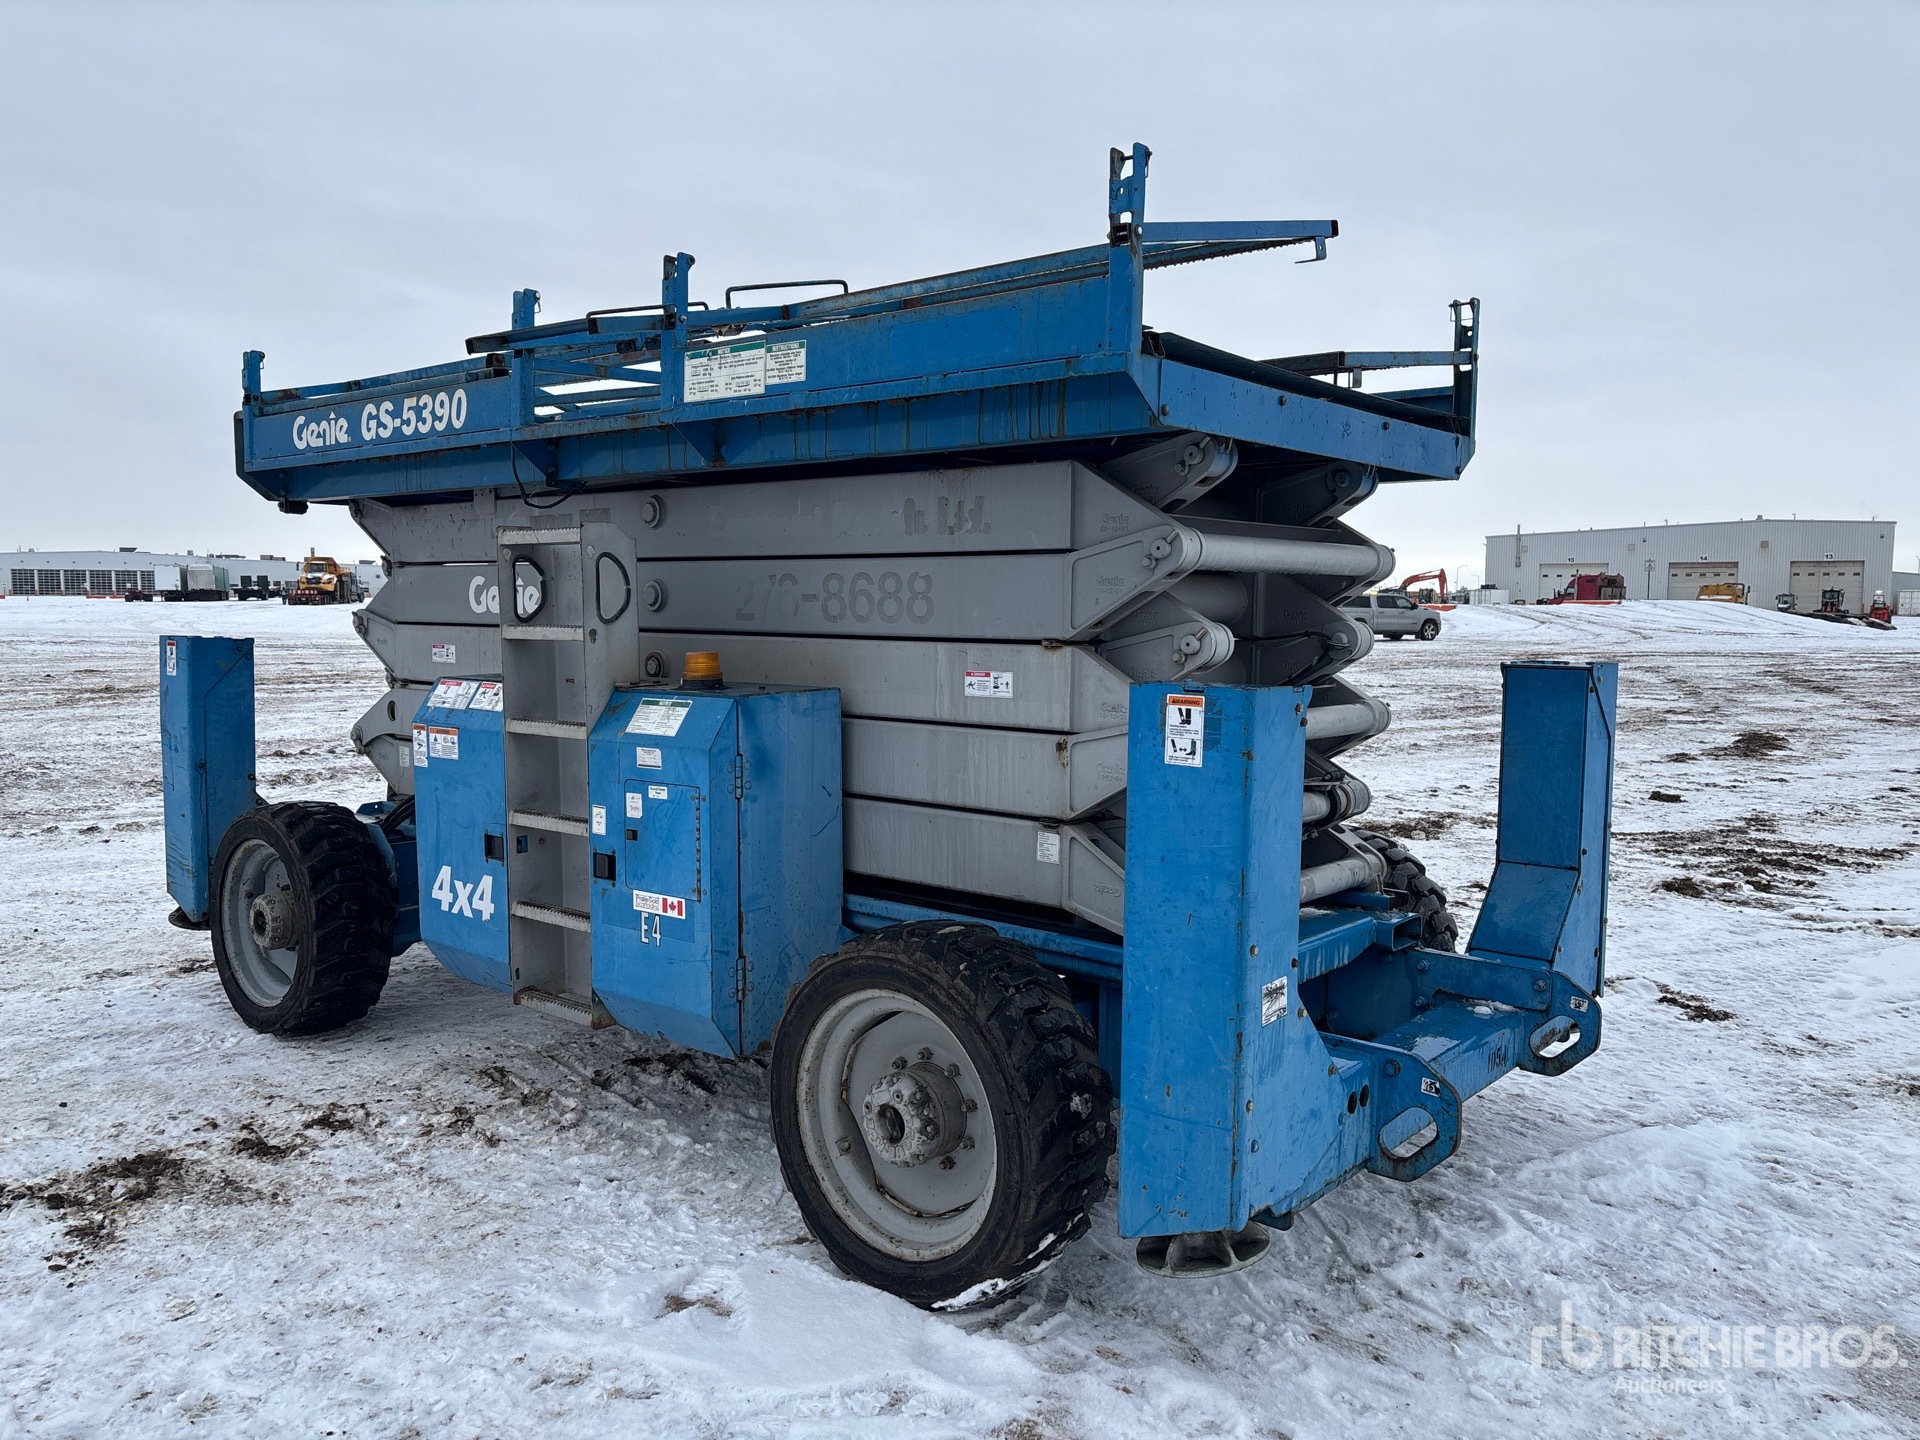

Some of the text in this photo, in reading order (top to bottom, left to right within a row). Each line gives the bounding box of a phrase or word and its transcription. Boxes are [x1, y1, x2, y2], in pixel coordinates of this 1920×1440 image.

[293, 388, 467, 450] Genie GS-5390
[1102, 513, 1129, 525] Genie
[469, 575, 540, 614] Geie
[1096, 575, 1124, 587] Genie
[431, 864, 495, 922] 4x4
